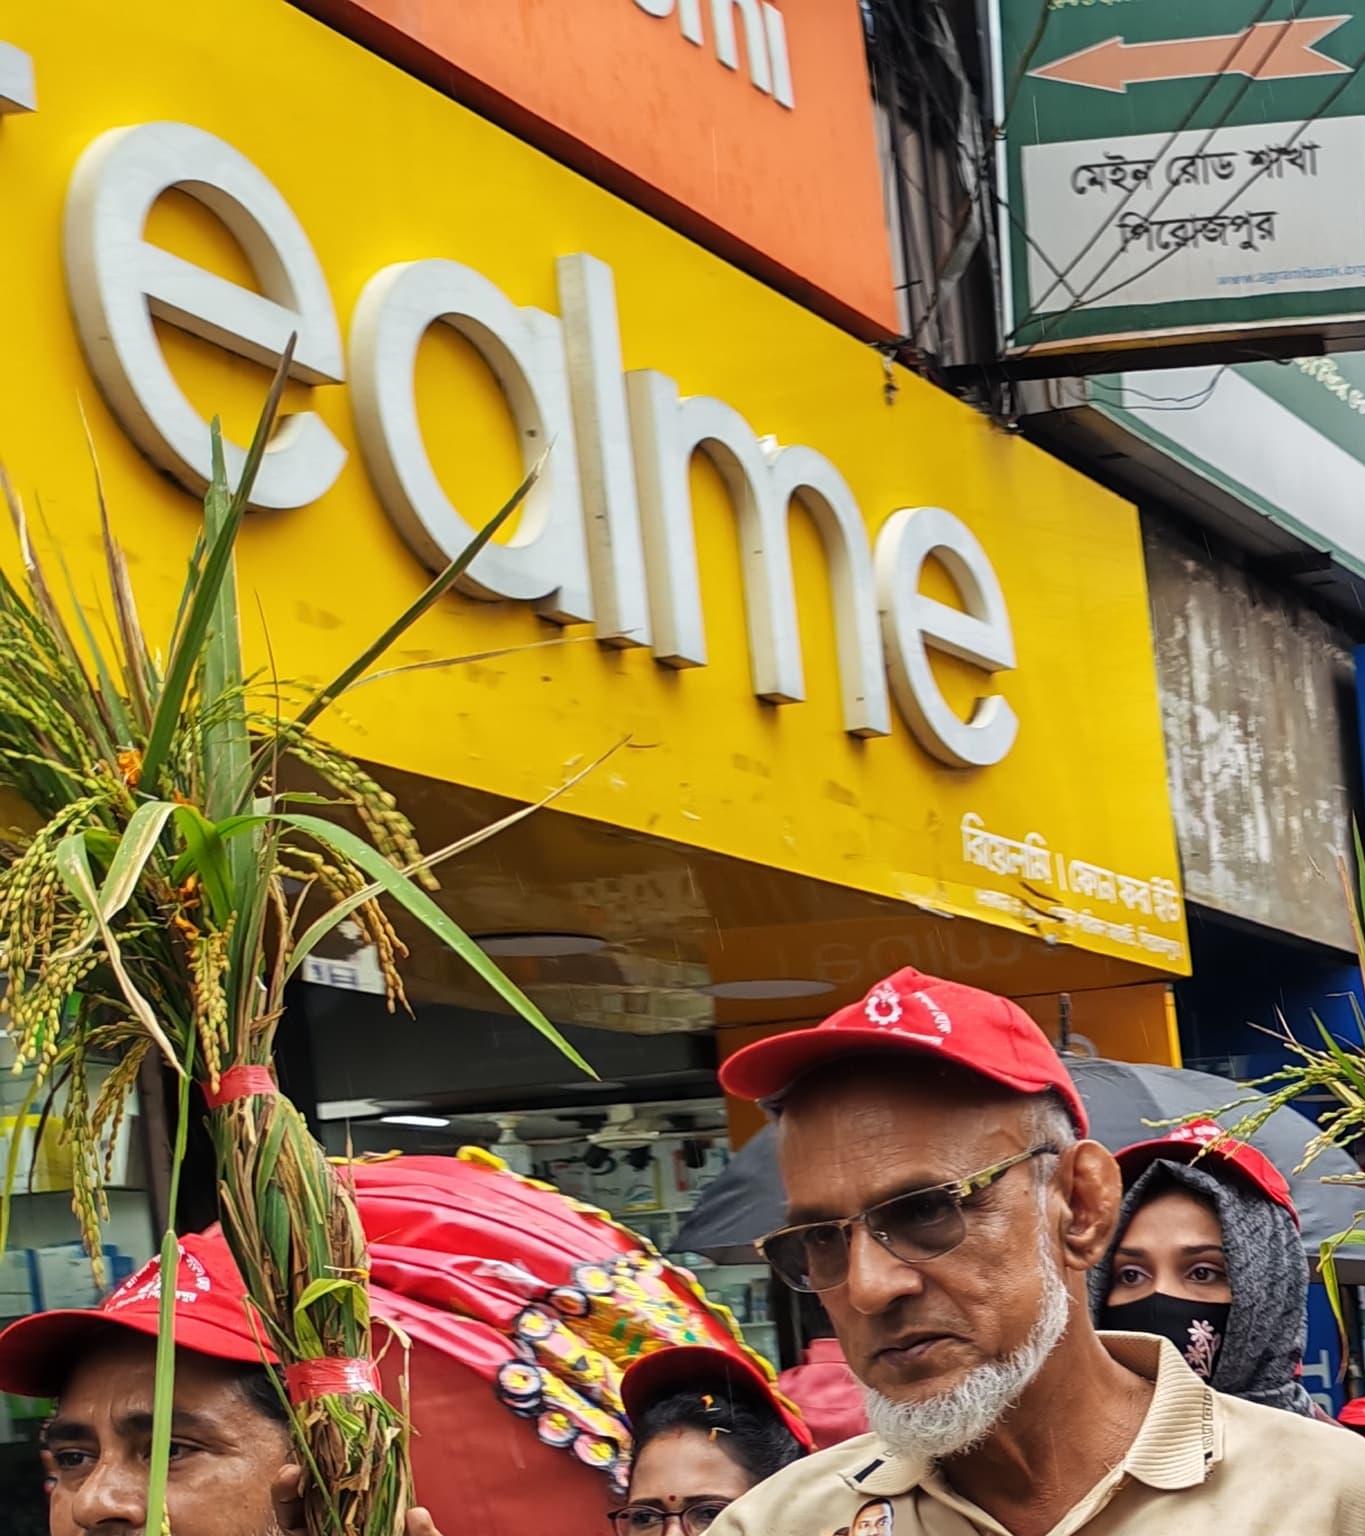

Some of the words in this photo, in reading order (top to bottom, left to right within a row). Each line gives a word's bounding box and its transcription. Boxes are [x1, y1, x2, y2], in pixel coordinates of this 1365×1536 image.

[1070, 151, 1156, 195] মেইন
[1166, 151, 1240, 188] রোড
[1247, 140, 1322, 180] শাখা
[1114, 210, 1279, 252] পিরোজপুর
[0, 42, 1020, 768] ealme
